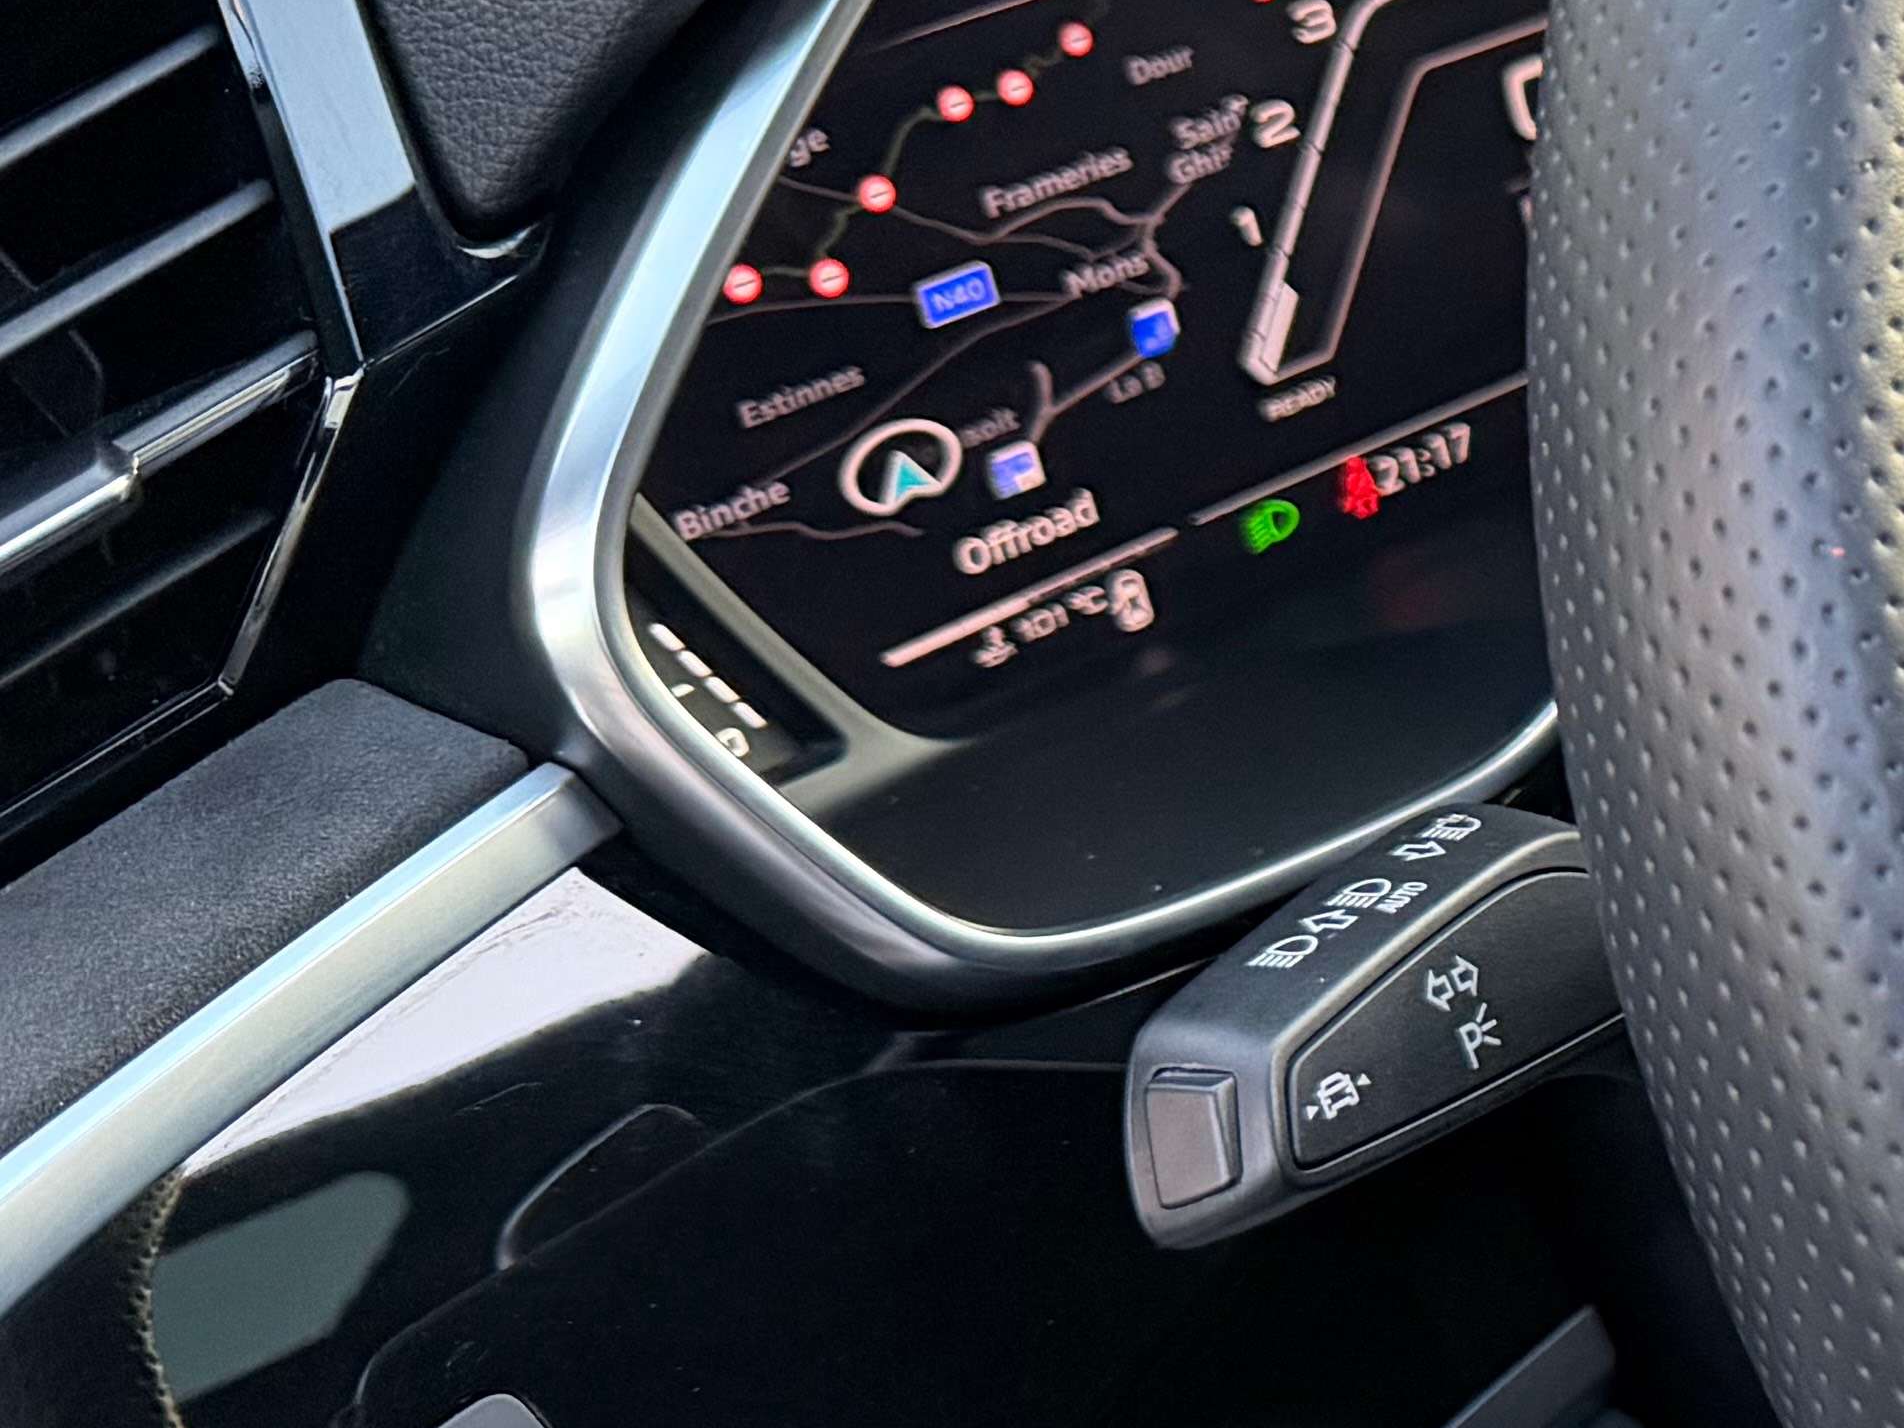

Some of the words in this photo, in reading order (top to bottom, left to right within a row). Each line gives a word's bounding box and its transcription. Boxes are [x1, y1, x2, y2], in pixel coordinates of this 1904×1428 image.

[1250, 98, 1301, 149] 2
[1229, 205, 1263, 248] 1
[1060, 250, 1149, 299] Mons
[736, 365, 867, 429] Estinnes
[1368, 422, 1471, 497] 21:17
[672, 480, 790, 542] Binche
[953, 486, 1100, 575] Offroad
[1378, 880, 1429, 915] AUTO
